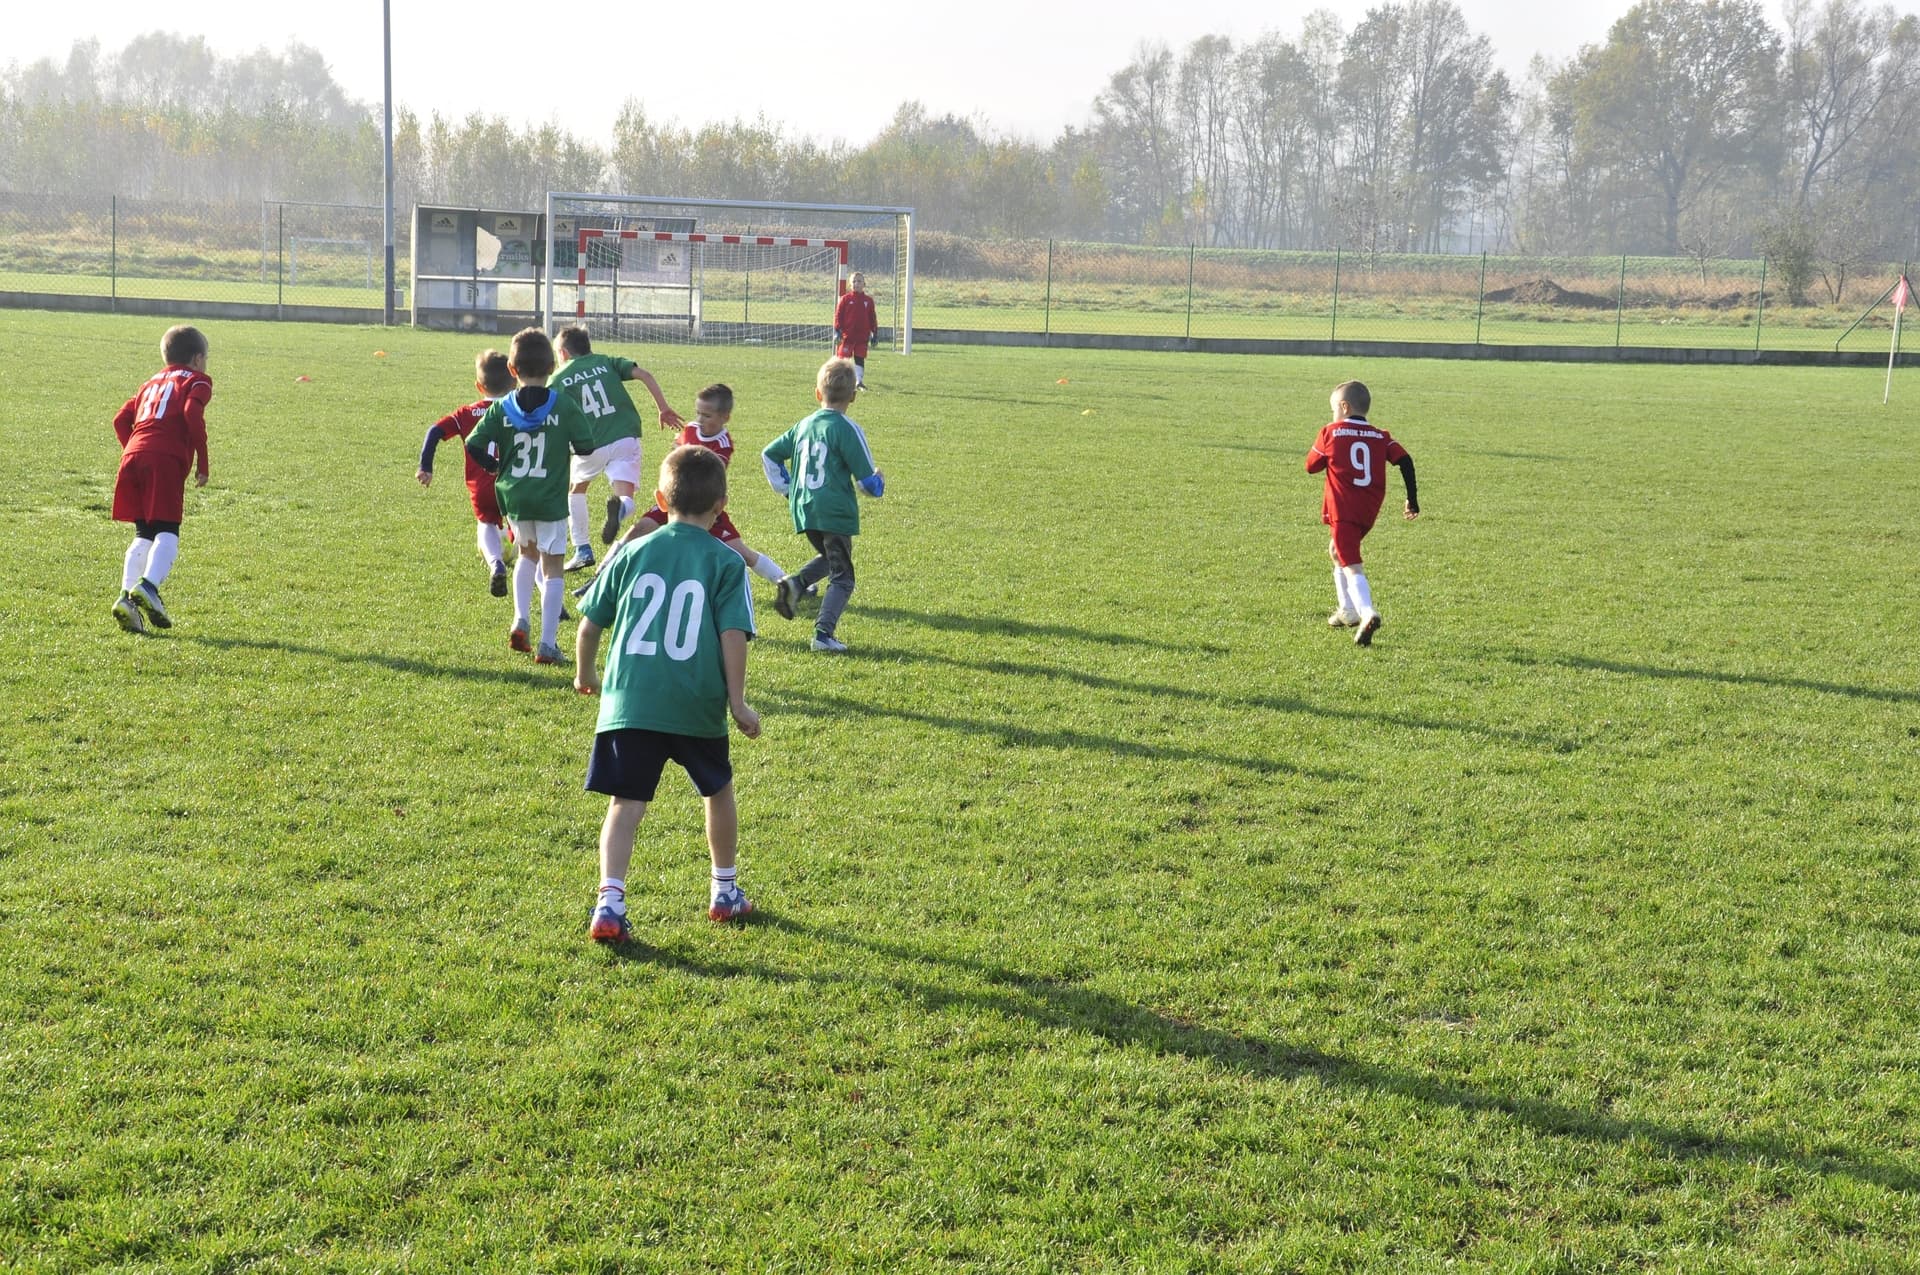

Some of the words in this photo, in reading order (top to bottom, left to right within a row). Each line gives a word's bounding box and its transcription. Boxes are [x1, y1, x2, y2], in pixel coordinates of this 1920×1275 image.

[561, 366, 608, 387] DALIN
[581, 379, 616, 418] 41
[511, 432, 547, 478] 31
[797, 439, 828, 490] 13
[1350, 441, 1371, 487] 9
[625, 572, 706, 661] 20
